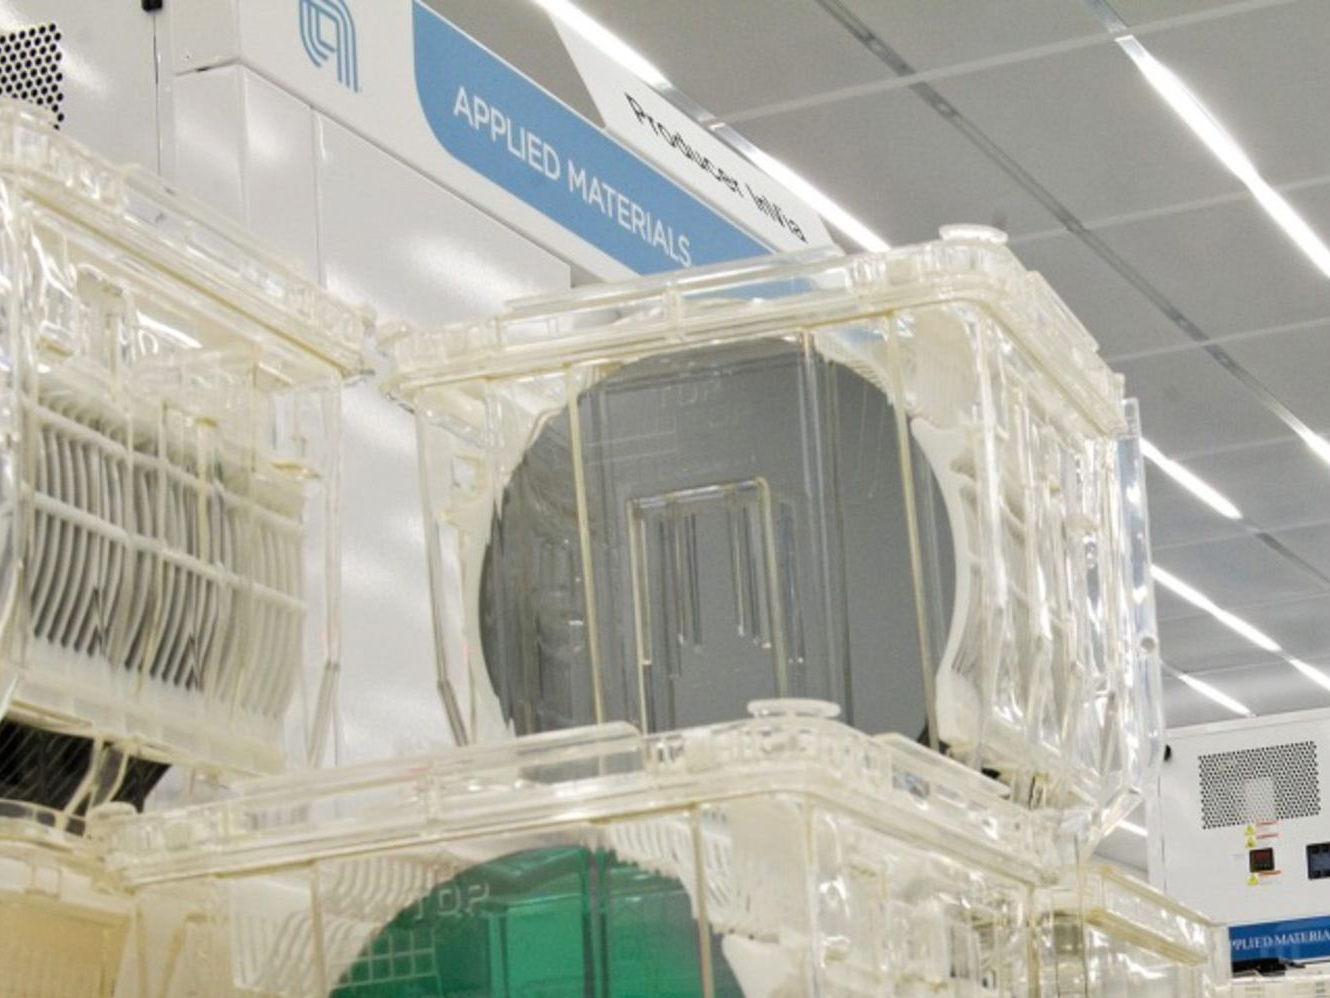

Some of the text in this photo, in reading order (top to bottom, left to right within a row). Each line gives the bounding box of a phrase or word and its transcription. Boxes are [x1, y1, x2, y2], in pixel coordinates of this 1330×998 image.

[453, 86, 692, 268] APPLIED MATERIALS
[624, 91, 744, 198] Producer
